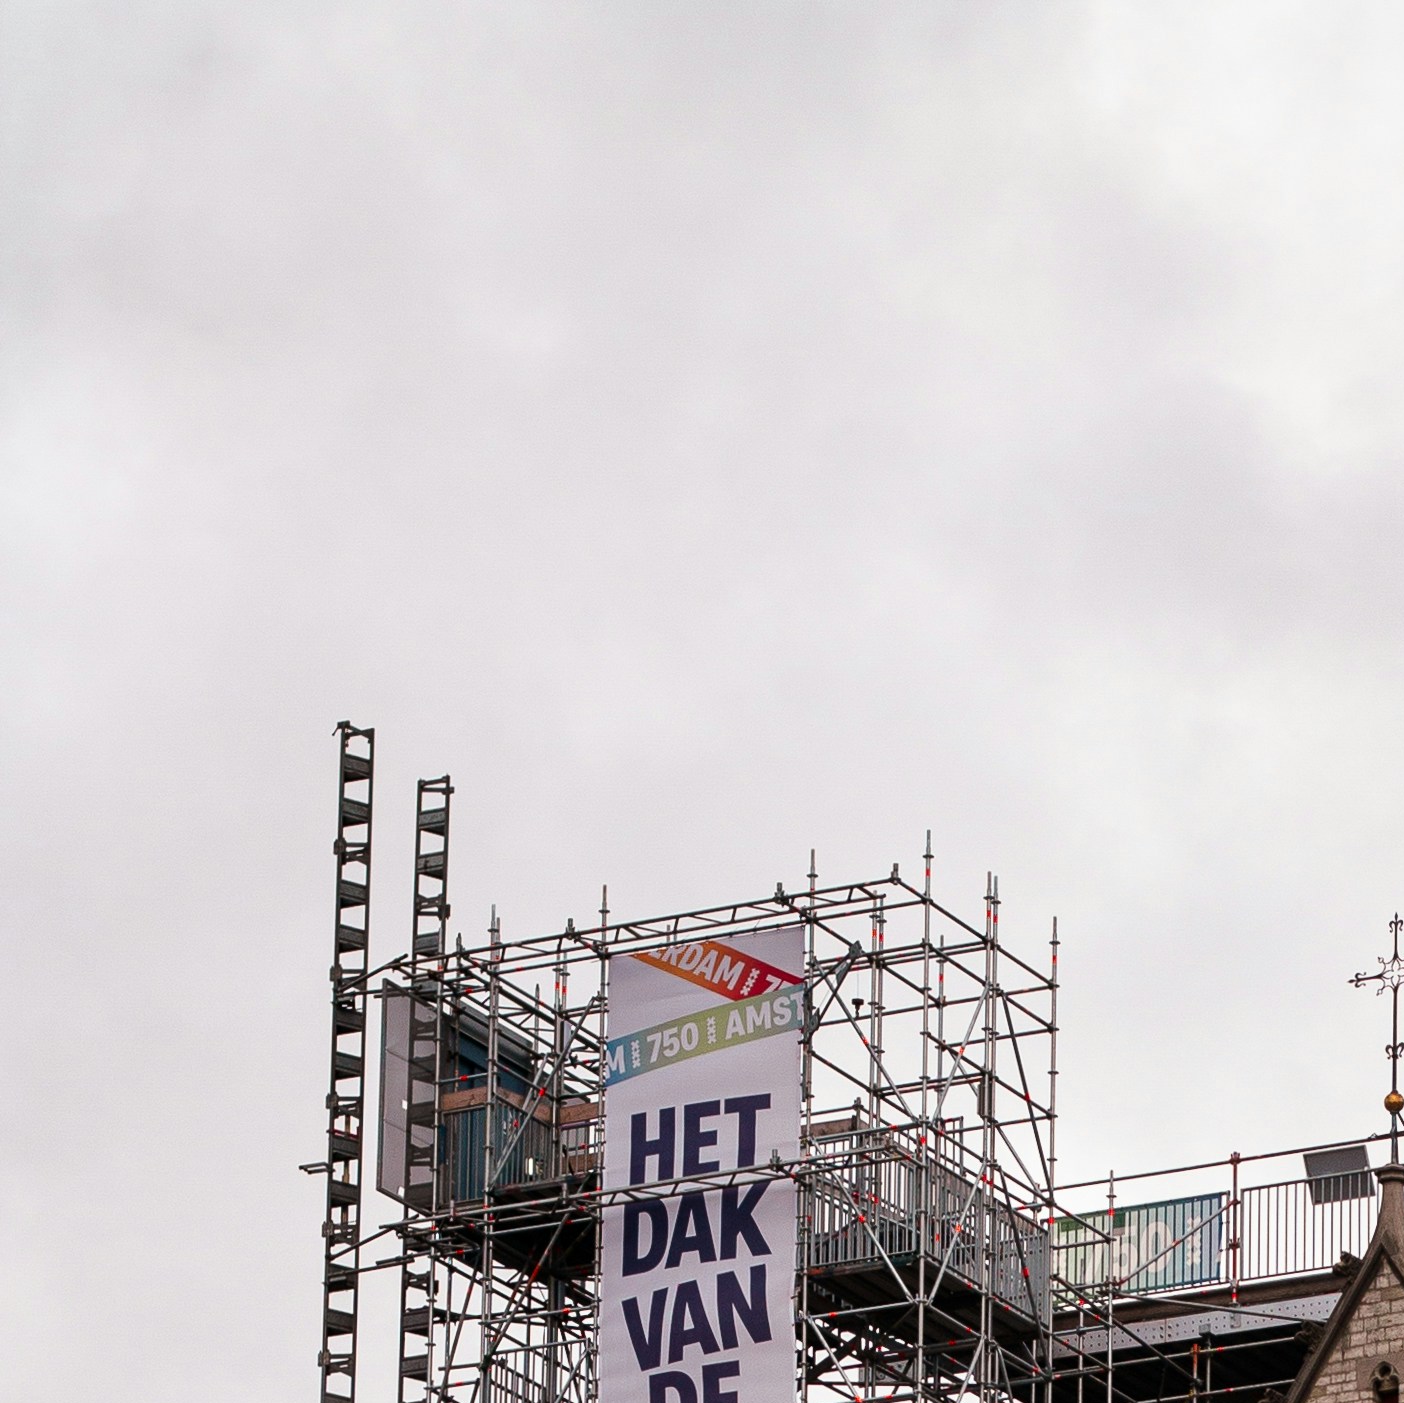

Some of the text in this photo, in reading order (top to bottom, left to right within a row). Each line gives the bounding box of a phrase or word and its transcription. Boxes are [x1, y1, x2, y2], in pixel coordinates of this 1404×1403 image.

[646, 1022, 699, 1064] 750
[629, 1093, 772, 1186] HET
[621, 1182, 772, 1277] DAK
[621, 1263, 772, 1372] VAN
